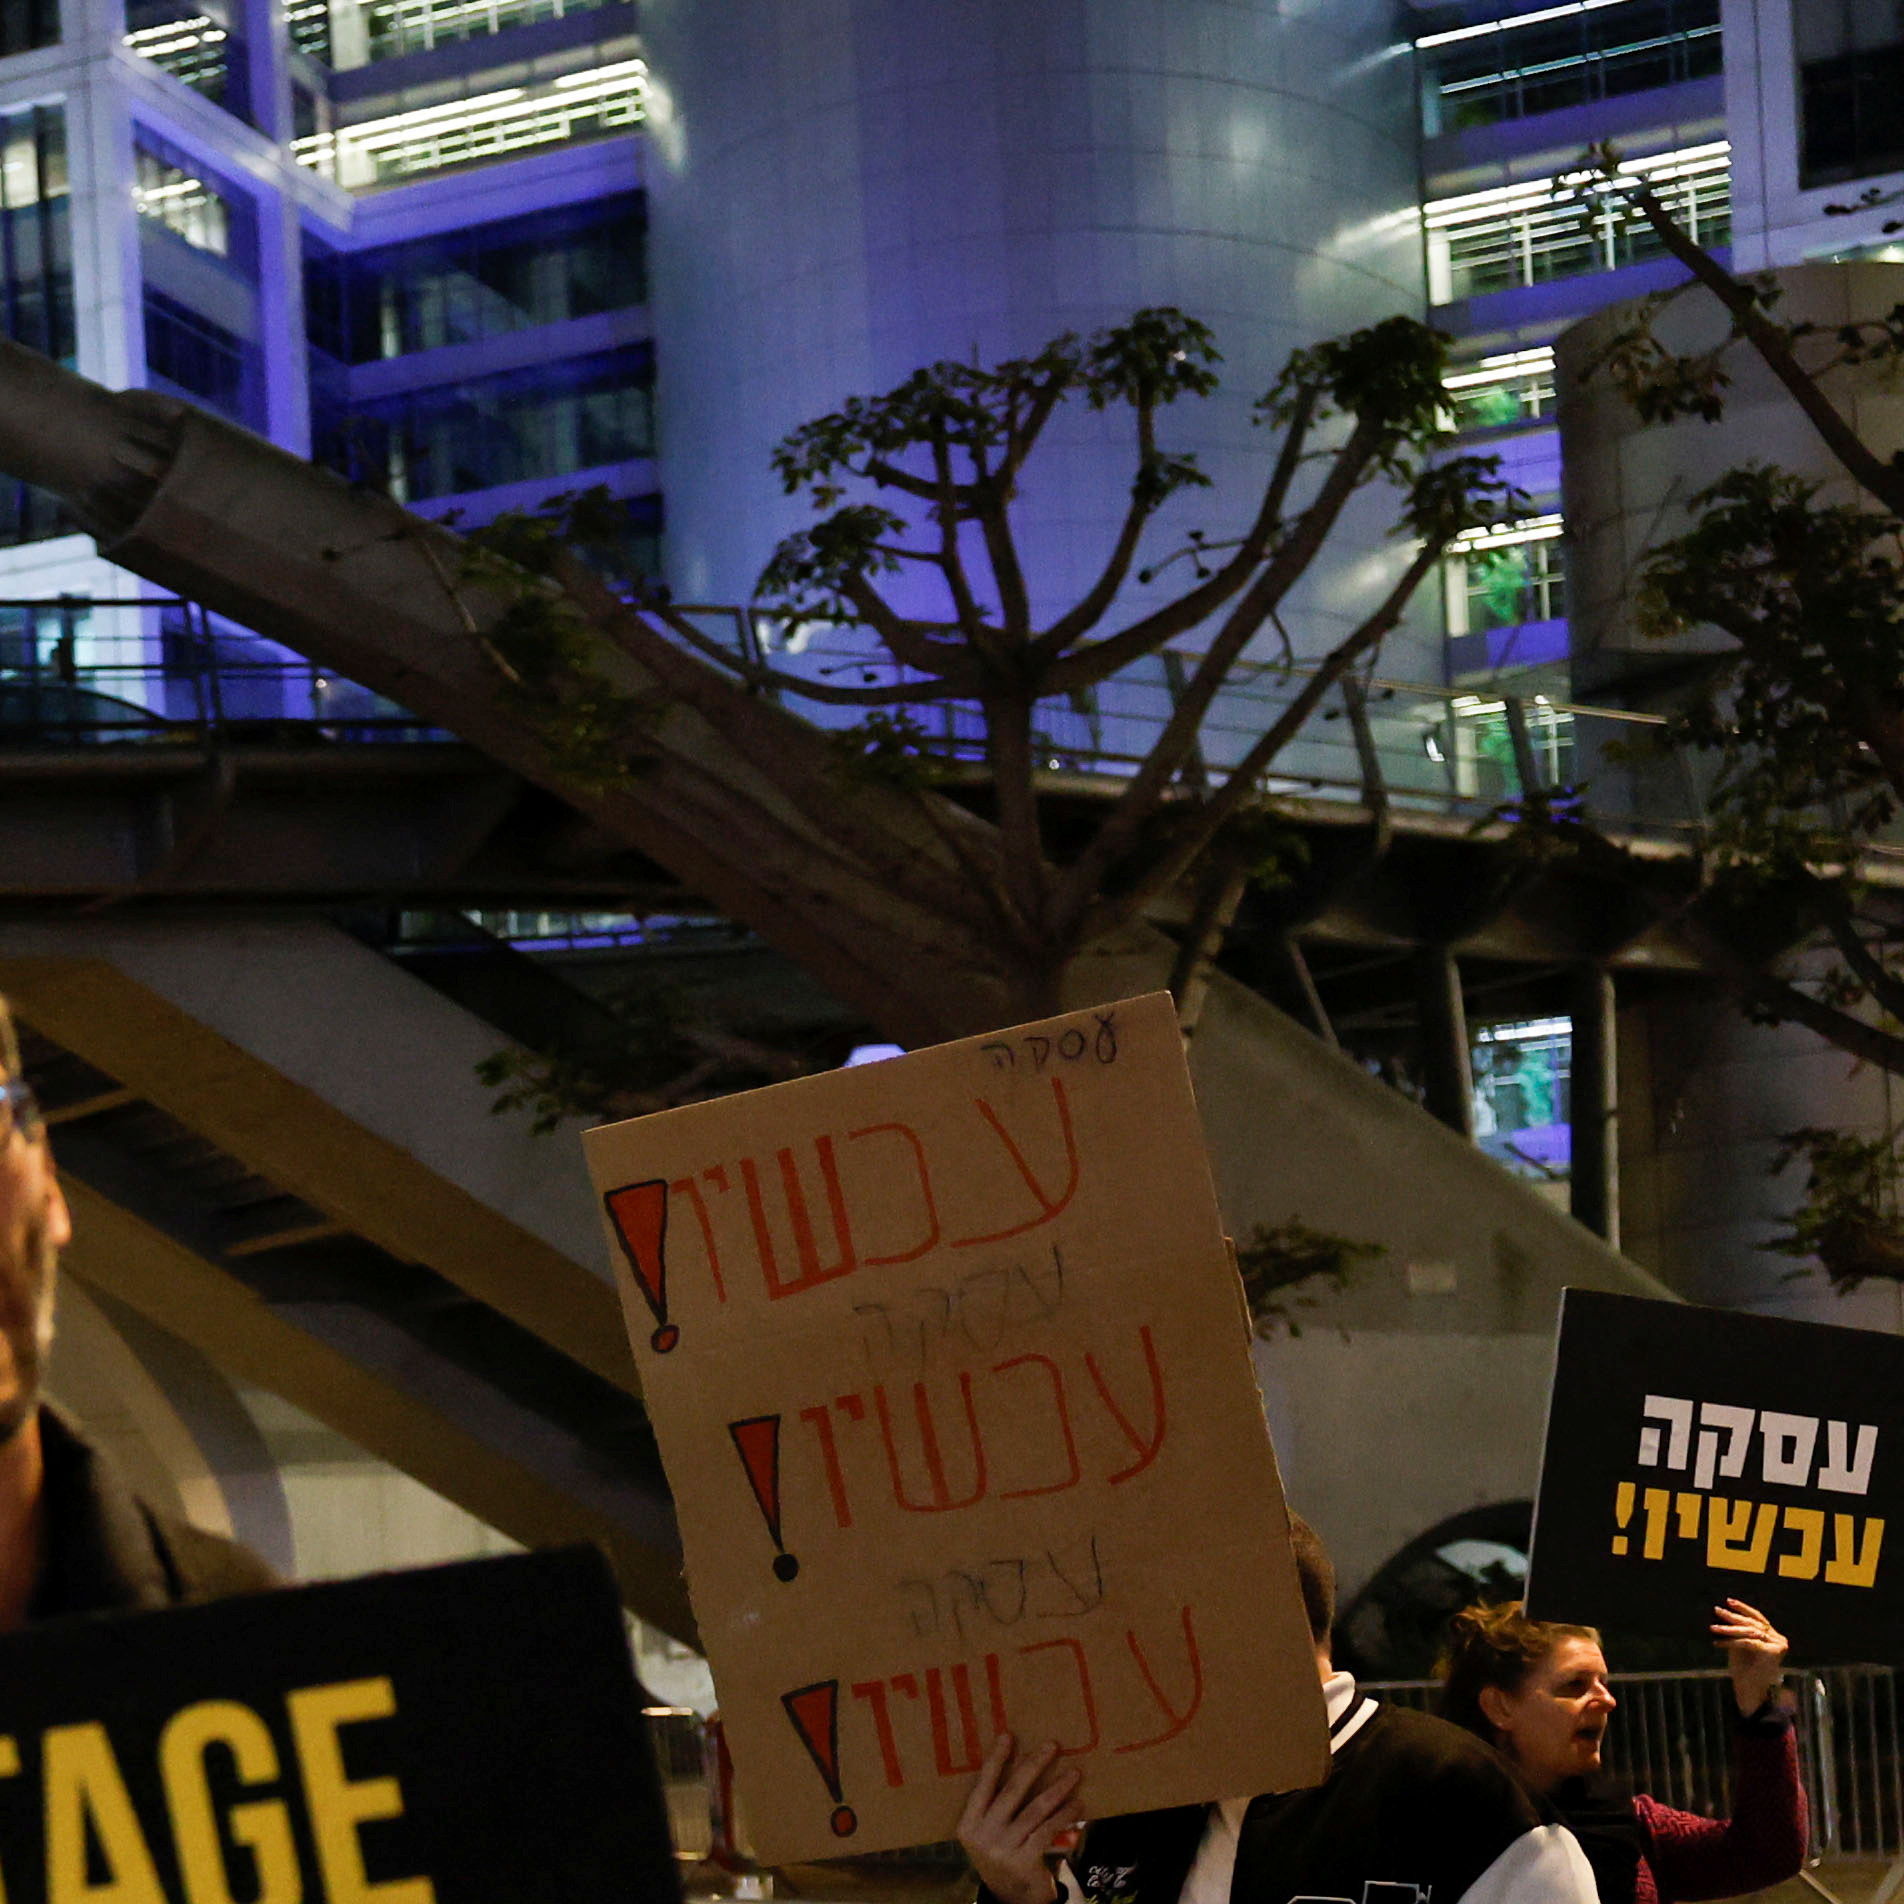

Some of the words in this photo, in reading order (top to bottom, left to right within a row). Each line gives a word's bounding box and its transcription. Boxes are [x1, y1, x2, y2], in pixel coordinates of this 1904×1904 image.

[981, 1012, 1118, 1072] עסקה
[1638, 1394, 1879, 1495] עסקה
[1611, 1480, 1885, 1588] עכשיו!
